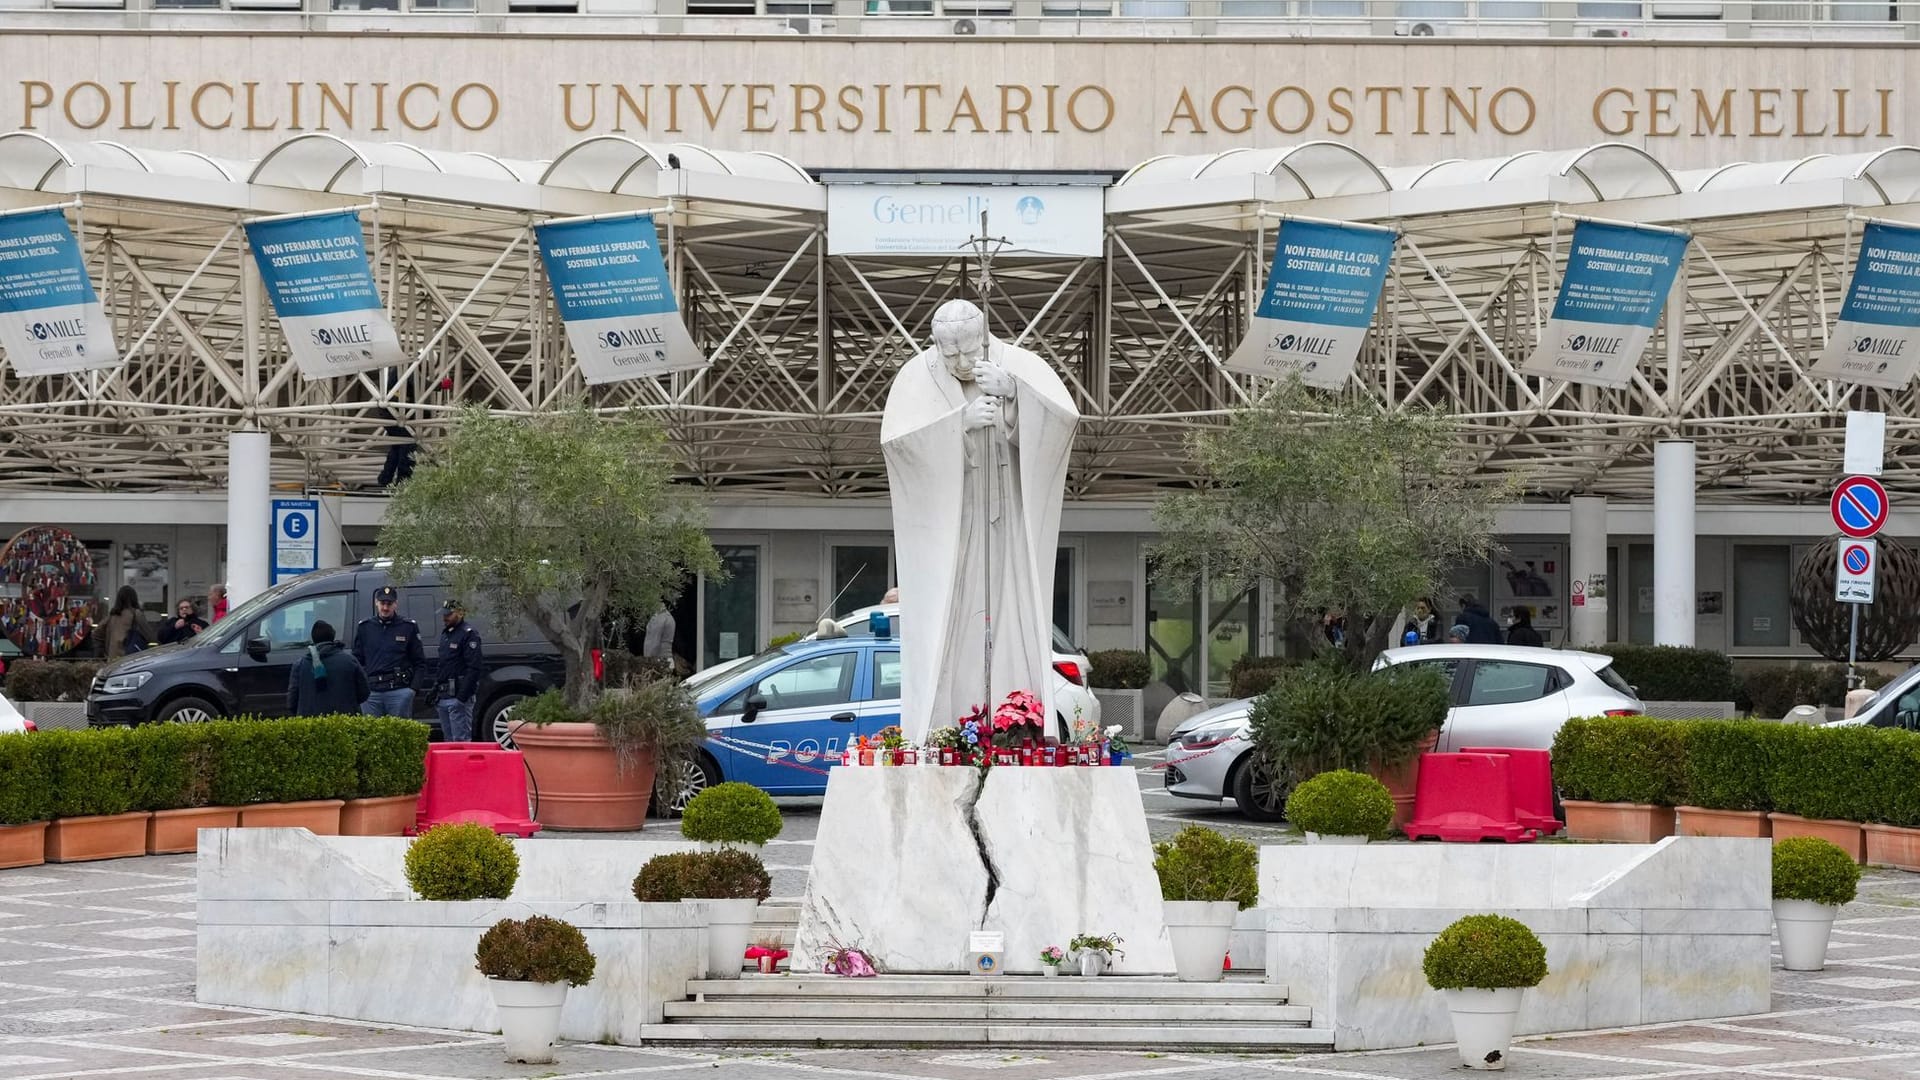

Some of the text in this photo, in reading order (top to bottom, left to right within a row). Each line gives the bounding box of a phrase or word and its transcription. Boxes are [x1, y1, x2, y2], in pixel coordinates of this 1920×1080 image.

[20, 81, 1894, 138] POLICLINICO UNIVERSITARIO AGOSTINO GEMELLI
[20, 237, 28, 245] LA
[262, 235, 359, 255] NON FERMARE LA CURA,
[550, 240, 650, 257] NON FERMARE LA SPERANZA,
[21, 250, 28, 258] LA
[272, 249, 358, 267] SOSTIENI LA RICERCA.
[1285, 244, 1381, 267] NON FERMARE LA CURA,
[1577, 246, 1595, 256] NON
[1595, 248, 1625, 259] FERMARE
[1625, 251, 1635, 260] LA
[1867, 247, 1887, 260] NON
[566, 254, 640, 269] SOSTIENI LA RICERCA.
[1287, 259, 1372, 277] SOSTIENI LA RICERCA.
[1586, 260, 1654, 276] SOSTIENI LA RICERCA.
[1868, 261, 1903, 274] SOSTIENI
[1903, 266, 1913, 276] LA
[291, 518, 300, 532] E
